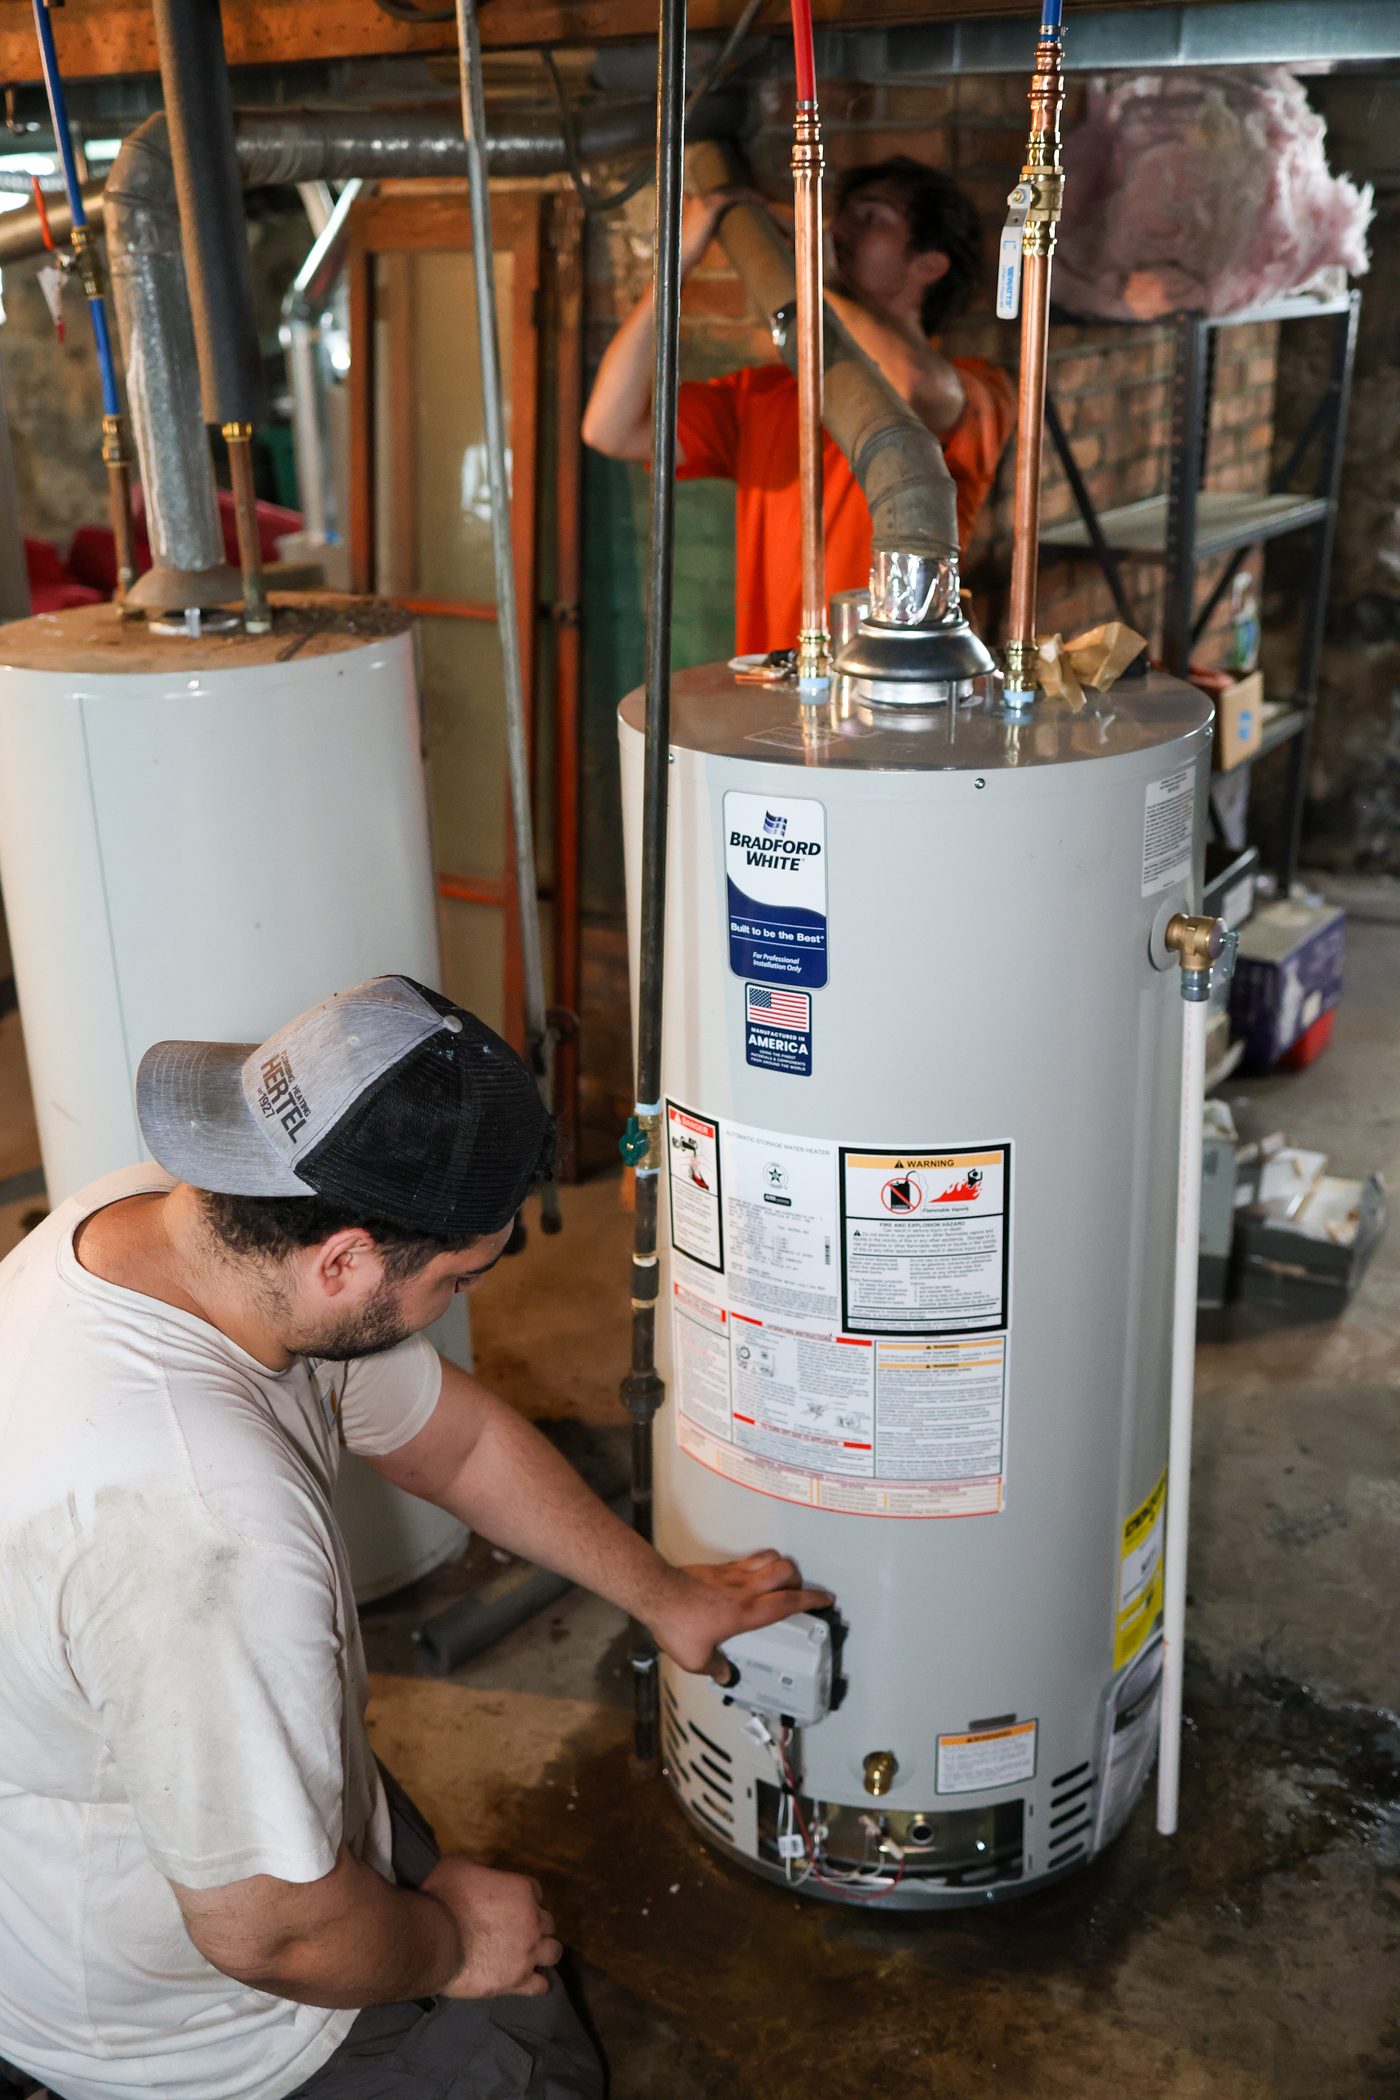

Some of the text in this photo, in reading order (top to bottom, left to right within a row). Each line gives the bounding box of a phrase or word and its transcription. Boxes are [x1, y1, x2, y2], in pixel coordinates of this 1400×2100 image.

[730, 832, 821, 856] BRADFORD
[746, 851, 801, 871] WHITE
[731, 922, 750, 934] Built
[752, 926, 761, 936] to
[763, 928, 776, 938] be
[778, 930, 794, 940] the
[753, 959, 802, 974] Installation Only
[763, 953, 800, 964] Professional
[751, 1027, 797, 1041] MANUFACTURED
[748, 1034, 809, 1055] AMERICA
[259, 1093, 275, 1119] 1927
[261, 1053, 307, 1144] HERTEL
[292, 1085, 311, 1117] HEATING
[681, 1117, 709, 1135] DANGER
[784, 1144, 804, 1152] WATER
[907, 1160, 955, 1168] WARNING
